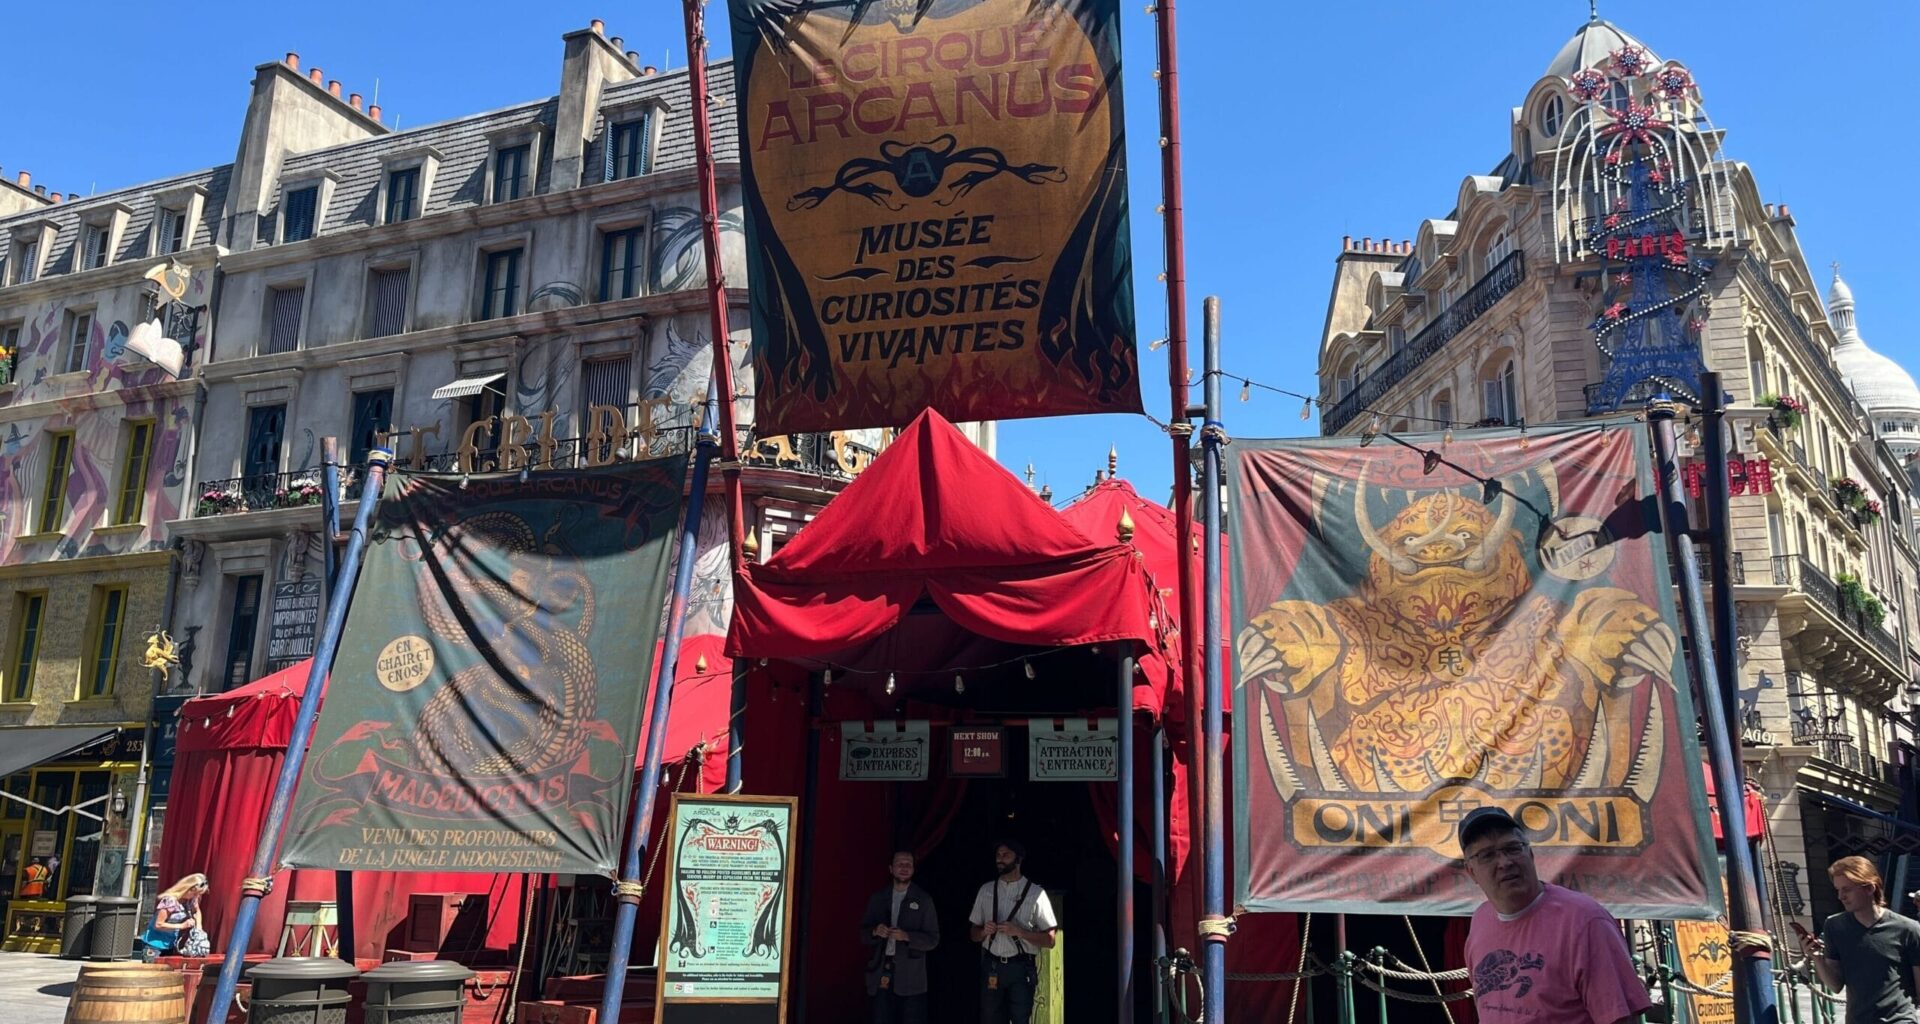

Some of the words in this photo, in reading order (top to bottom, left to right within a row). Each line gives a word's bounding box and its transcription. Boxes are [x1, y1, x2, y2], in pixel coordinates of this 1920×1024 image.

[842, 22, 1051, 84] CIRQUE
[758, 64, 1097, 152] ARCANUS
[855, 211, 994, 264] MUSÉE
[1606, 230, 1685, 260] PARIS
[895, 256, 956, 283] DES
[821, 273, 1041, 325] CURIOSITÉS
[839, 319, 1025, 369] VIVANTES
[396, 639, 411, 654] EN
[378, 652, 415, 672] CHAIR
[416, 647, 431, 662] ET
[954, 732, 975, 740] NEXT
[977, 732, 999, 740] SHOW
[872, 747, 918, 758] EXPRESS
[1040, 746, 1112, 757] ATTRACTION
[856, 759, 912, 771] ENTRANCE
[1047, 759, 1107, 770] ENTRANCE
[1313, 800, 1412, 843] ONI
[1514, 799, 1621, 842] ONI
[361, 827, 406, 846] VENU
[408, 827, 439, 846] DES
[442, 828, 558, 847] PROFONDEURS
[707, 837, 758, 850] WARNING!
[339, 848, 364, 864] DE
[365, 849, 387, 866] LA
[386, 850, 450, 868] JUNGLE
[451, 847, 564, 868] INDONÉSIENNE
